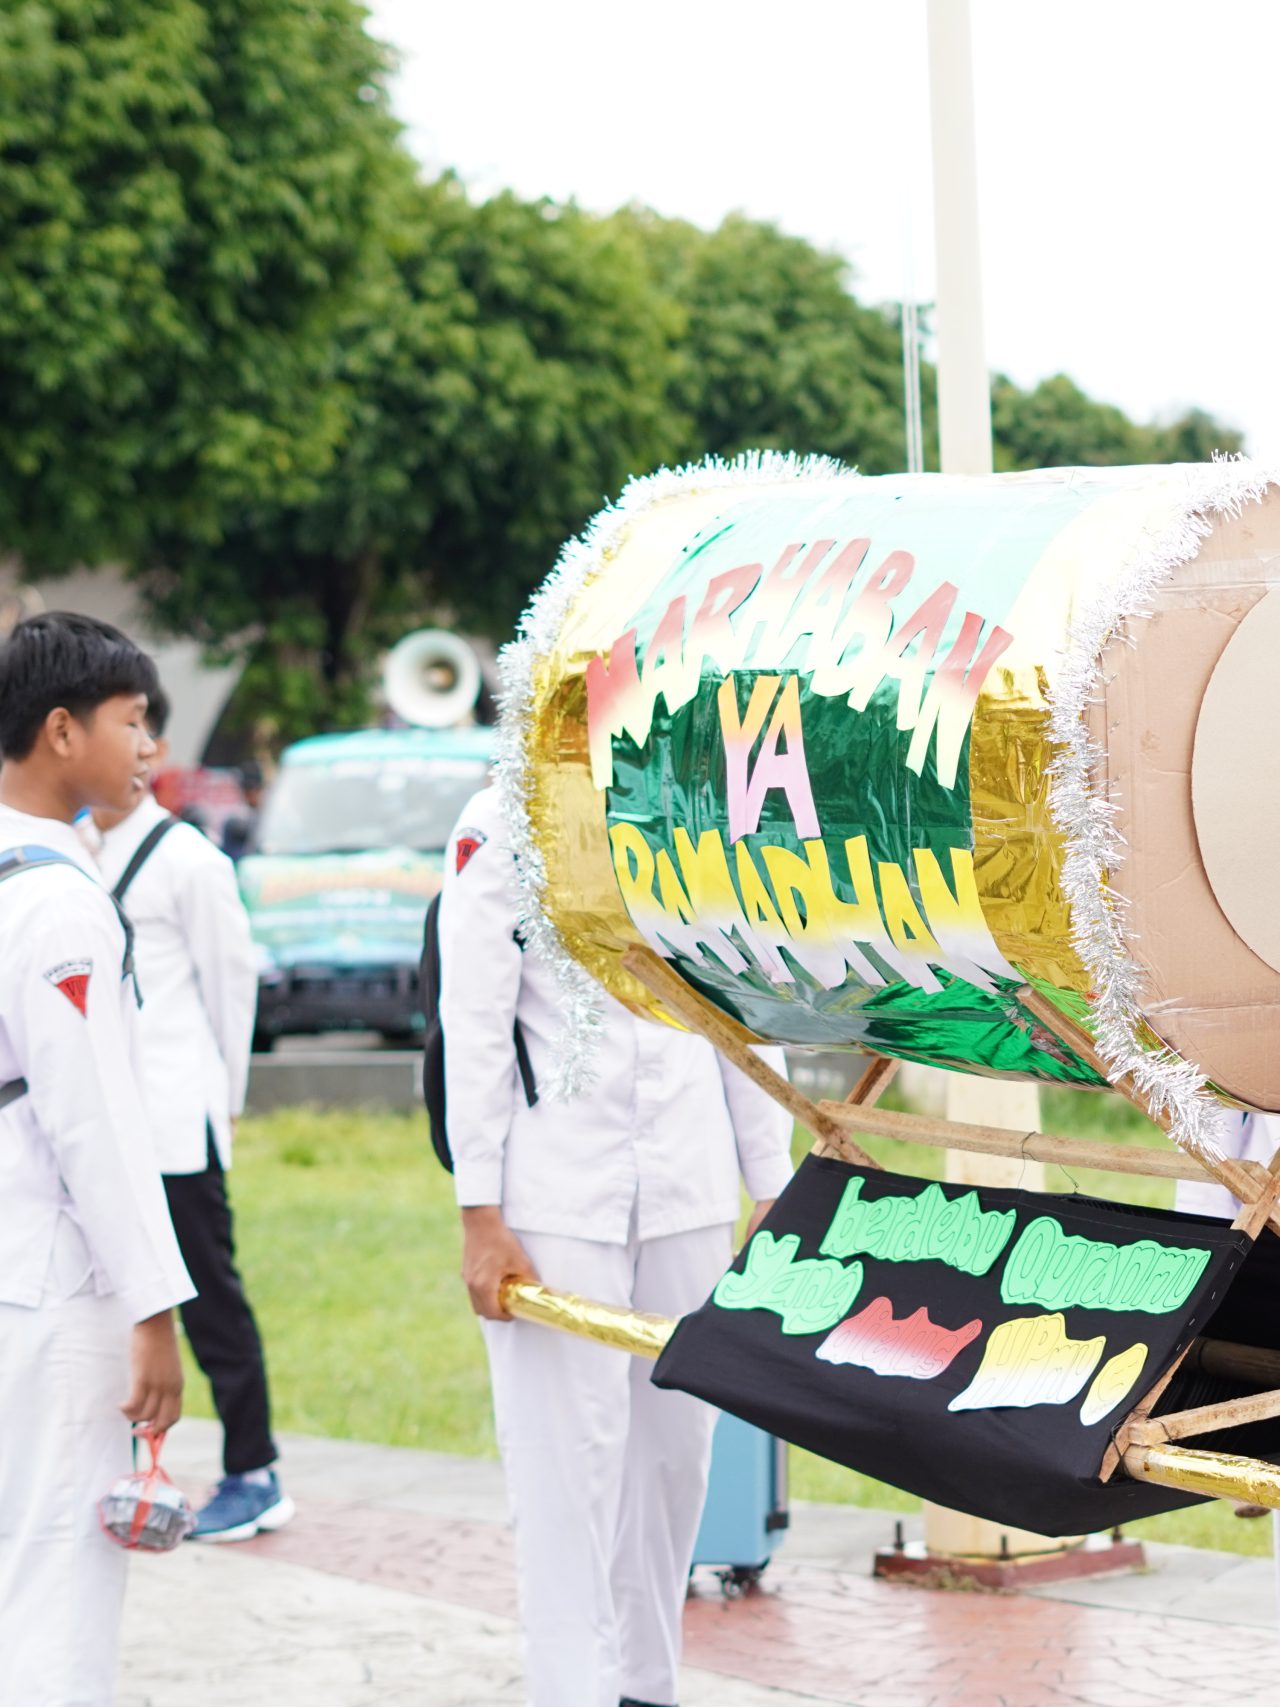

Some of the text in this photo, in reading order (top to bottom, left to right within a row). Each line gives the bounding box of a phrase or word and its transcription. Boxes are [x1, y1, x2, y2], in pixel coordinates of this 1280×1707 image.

[587, 539, 1013, 790] MARHABAN
[718, 675, 821, 844] YA
[609, 823, 1027, 993] RAMADHAN
[716, 1233, 862, 1333] Yang
